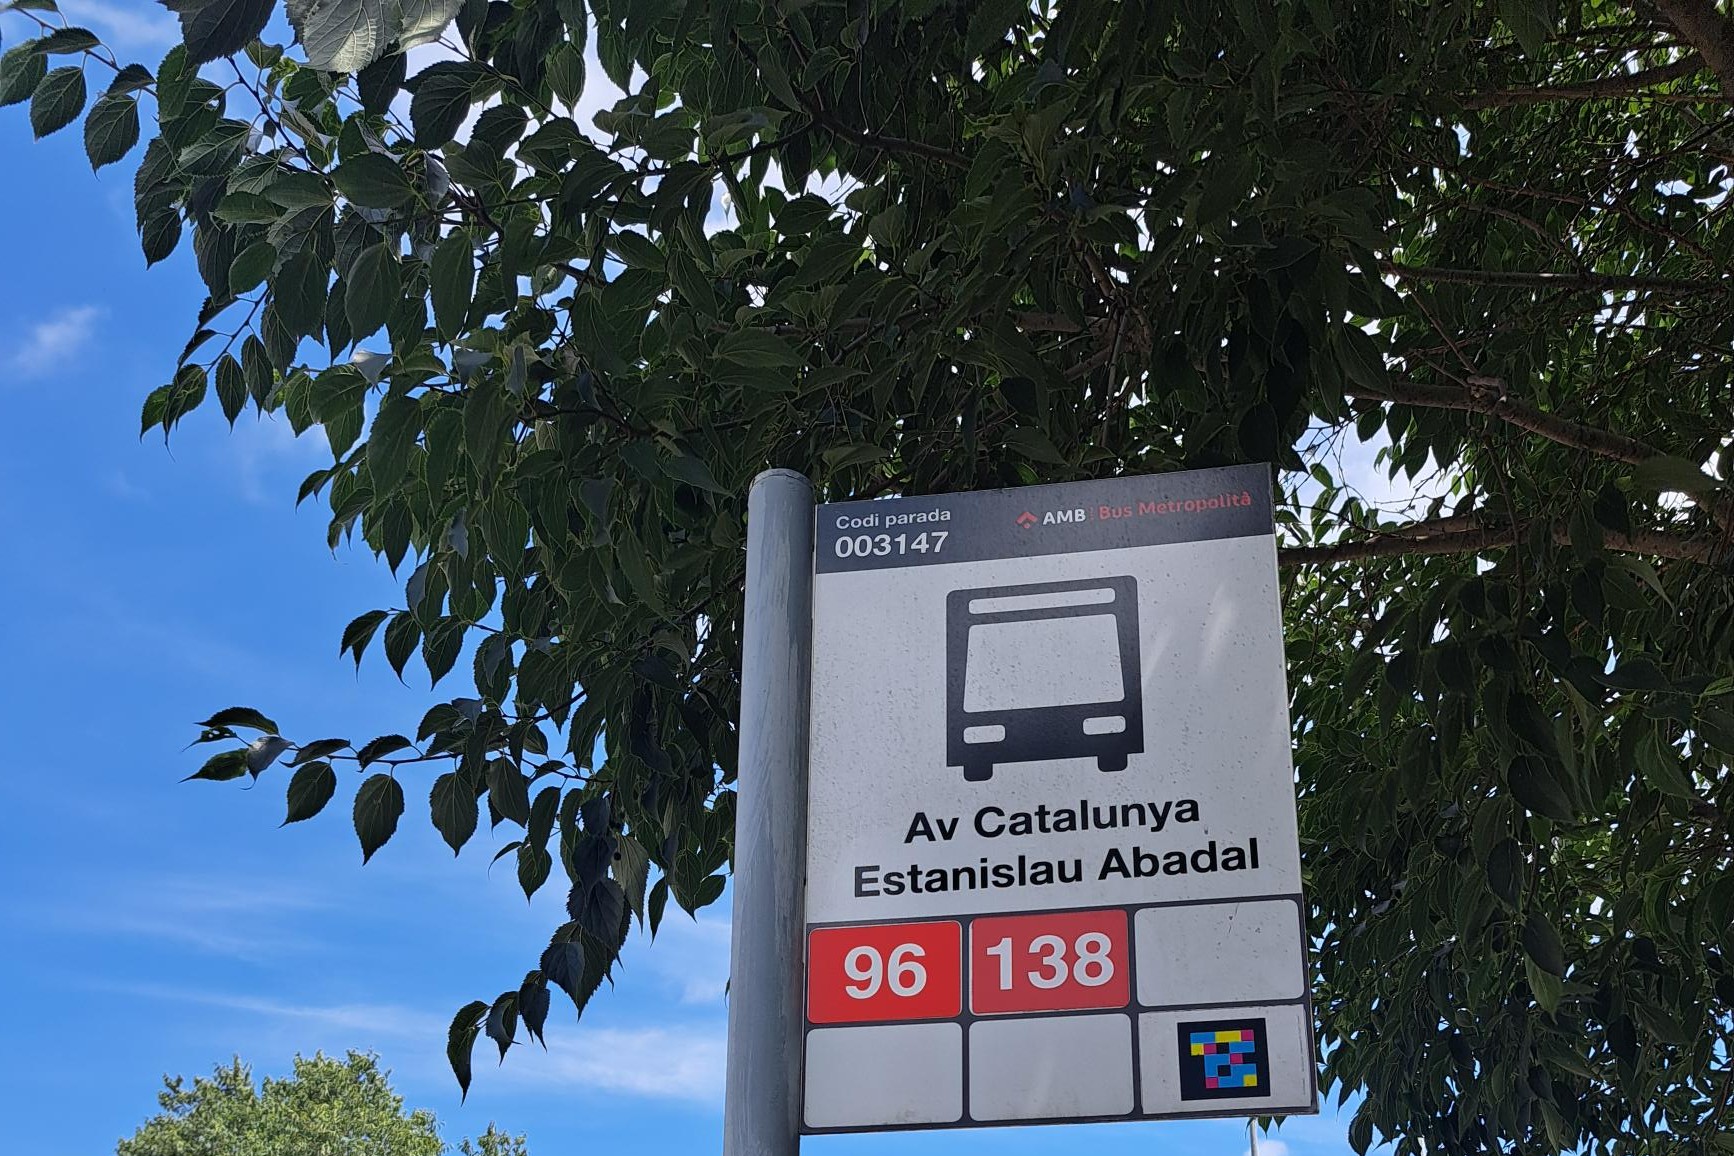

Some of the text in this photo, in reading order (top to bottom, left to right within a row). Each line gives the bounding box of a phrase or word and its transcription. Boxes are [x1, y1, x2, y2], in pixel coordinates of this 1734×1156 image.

[836, 508, 951, 530] Codi parada
[1043, 491, 1252, 525] AMB Bus Metropolità
[834, 531, 949, 558] 003147
[904, 799, 1200, 844] Av Catalunya
[854, 838, 1259, 897] Estanislau Abadal
[844, 943, 927, 999] 96
[986, 932, 1114, 990] 138
